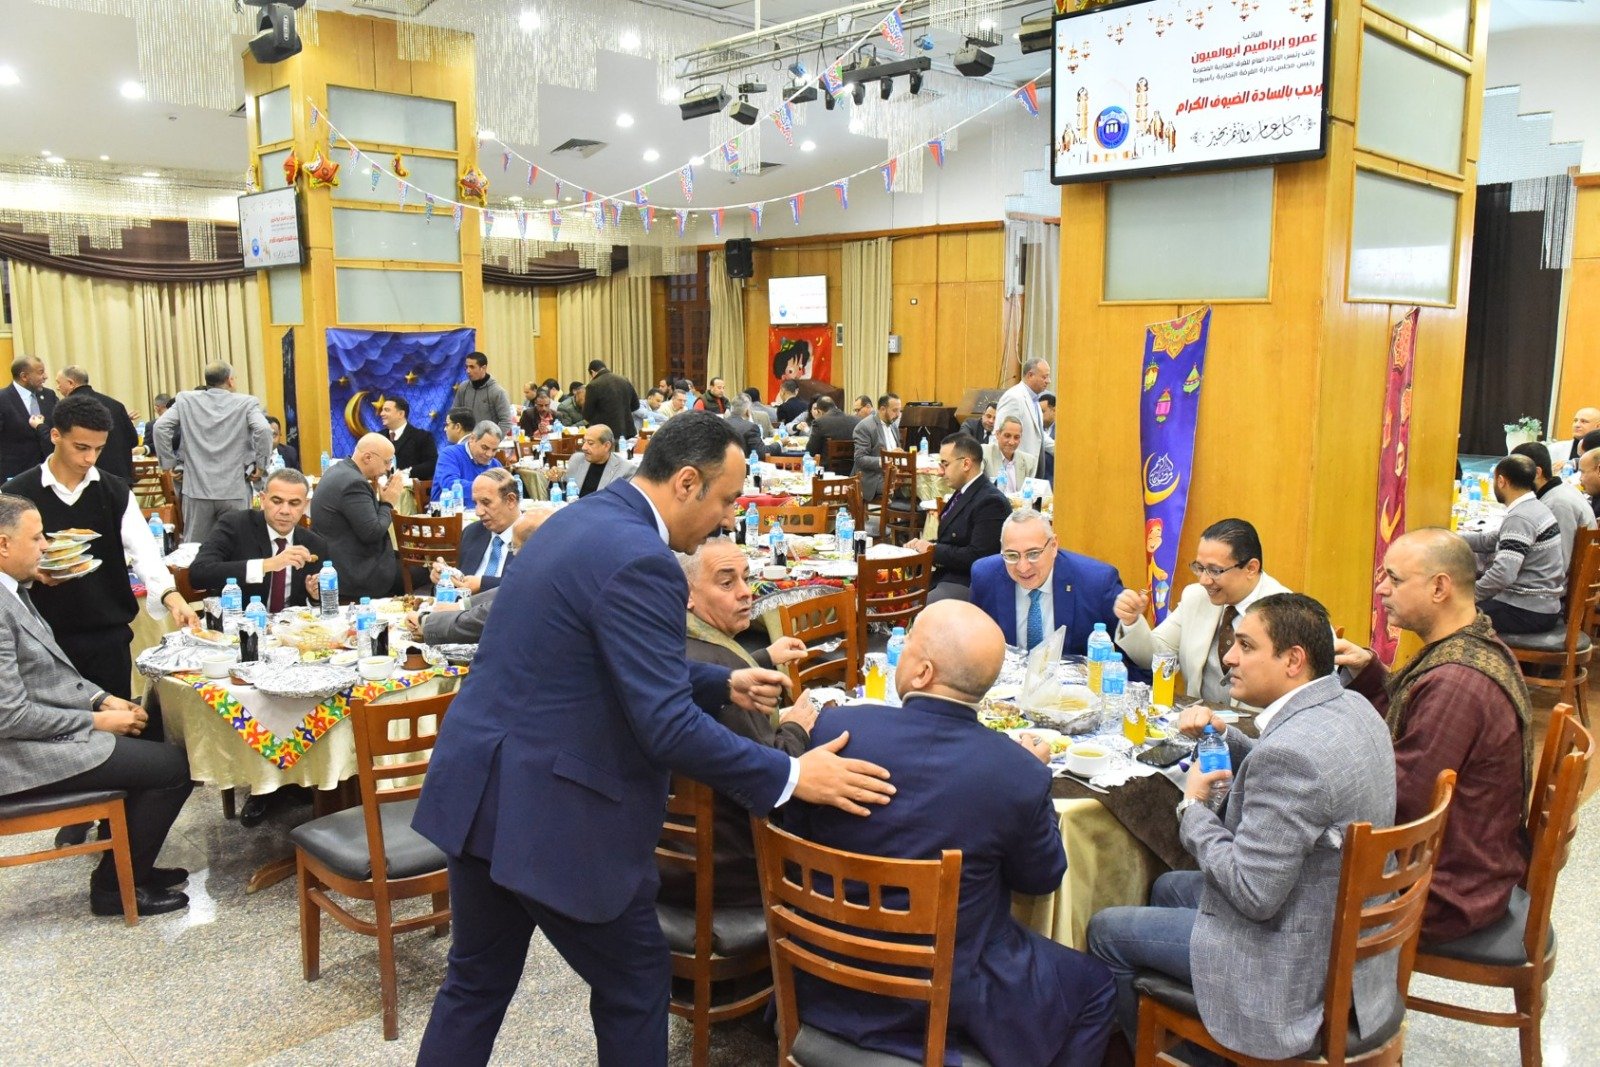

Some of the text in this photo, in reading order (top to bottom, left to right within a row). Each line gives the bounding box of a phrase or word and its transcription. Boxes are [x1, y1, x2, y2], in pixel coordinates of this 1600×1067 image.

[1288, 33, 1318, 47] عمرو
[1176, 84, 1323, 115] يرحب بالسادة الضيوف الكرام
